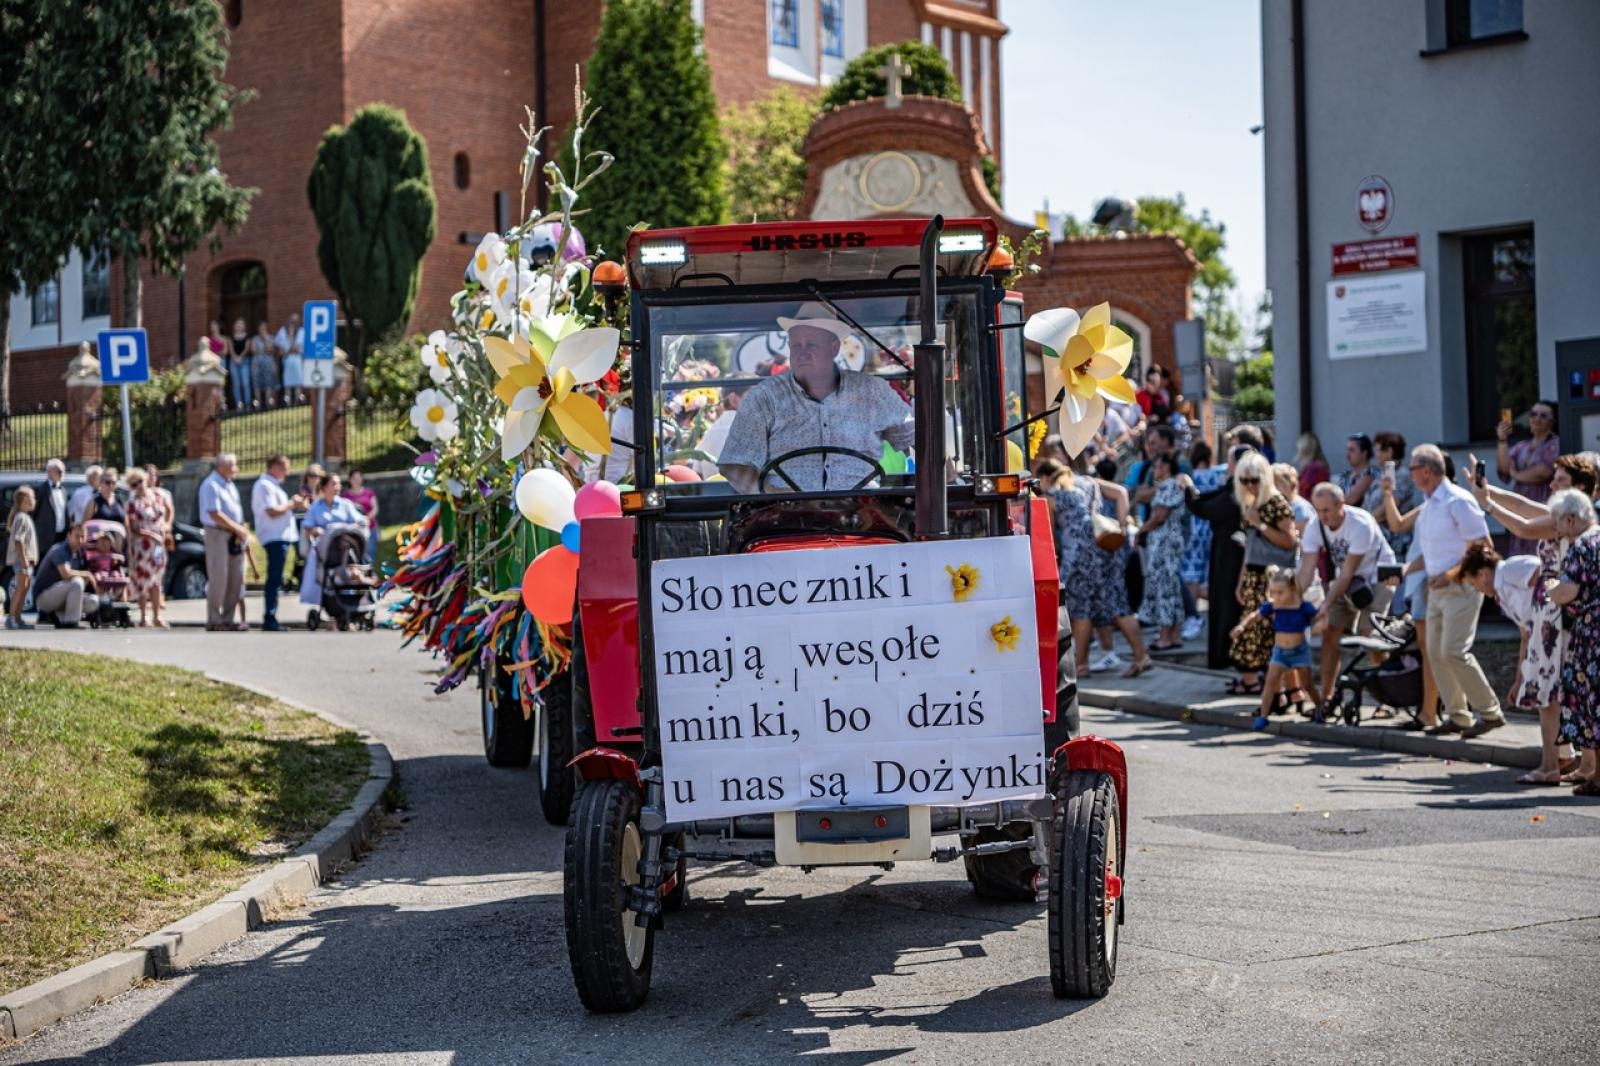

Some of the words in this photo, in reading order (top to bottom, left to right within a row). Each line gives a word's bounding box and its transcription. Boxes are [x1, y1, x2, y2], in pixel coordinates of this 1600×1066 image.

[751, 232, 866, 251] URSUS
[310, 306, 330, 342] P
[109, 335, 138, 378] P
[663, 636, 766, 682] mają
[800, 625, 941, 668] wesołe
[667, 700, 801, 743] minki,
[823, 698, 872, 733] bo
[907, 690, 985, 729] dziś
[670, 777, 696, 804] u
[720, 773, 785, 802] nas
[809, 771, 850, 806] są
[872, 752, 1044, 801] Dożynki
